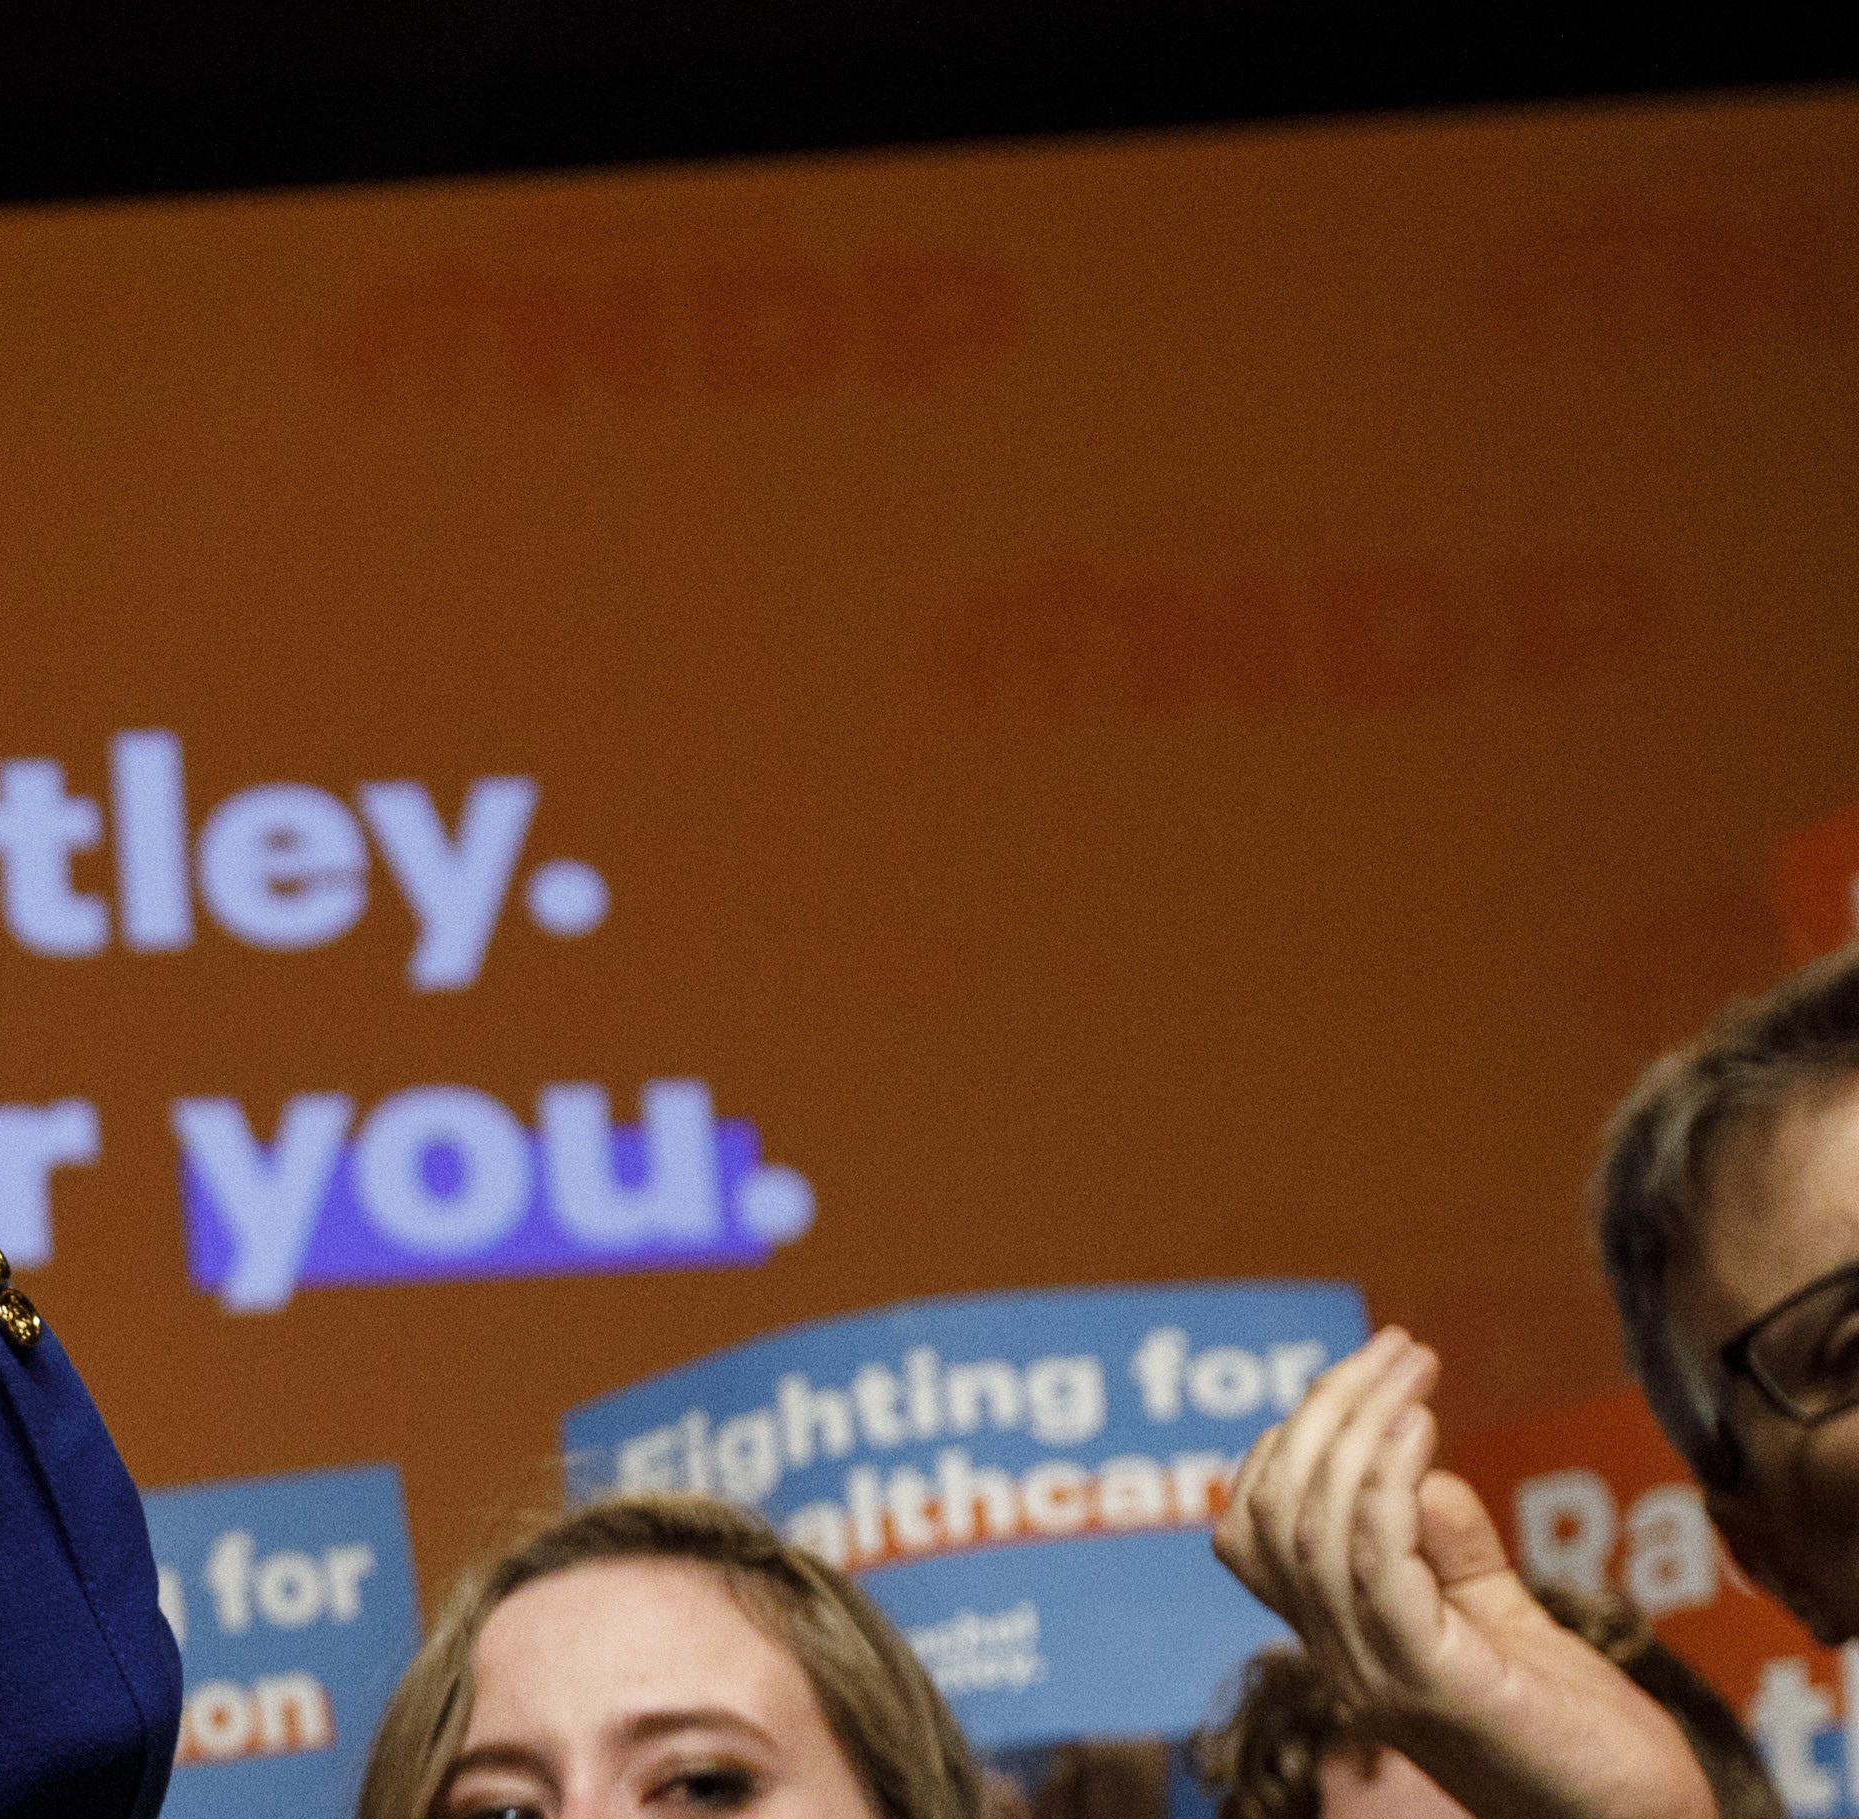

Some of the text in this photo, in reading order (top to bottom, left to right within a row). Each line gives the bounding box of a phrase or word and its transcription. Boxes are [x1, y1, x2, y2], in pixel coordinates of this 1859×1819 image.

[508, 250, 1019, 402] NDP
[173, 1079, 817, 1313] you.
[203, 1530, 378, 1636] for
